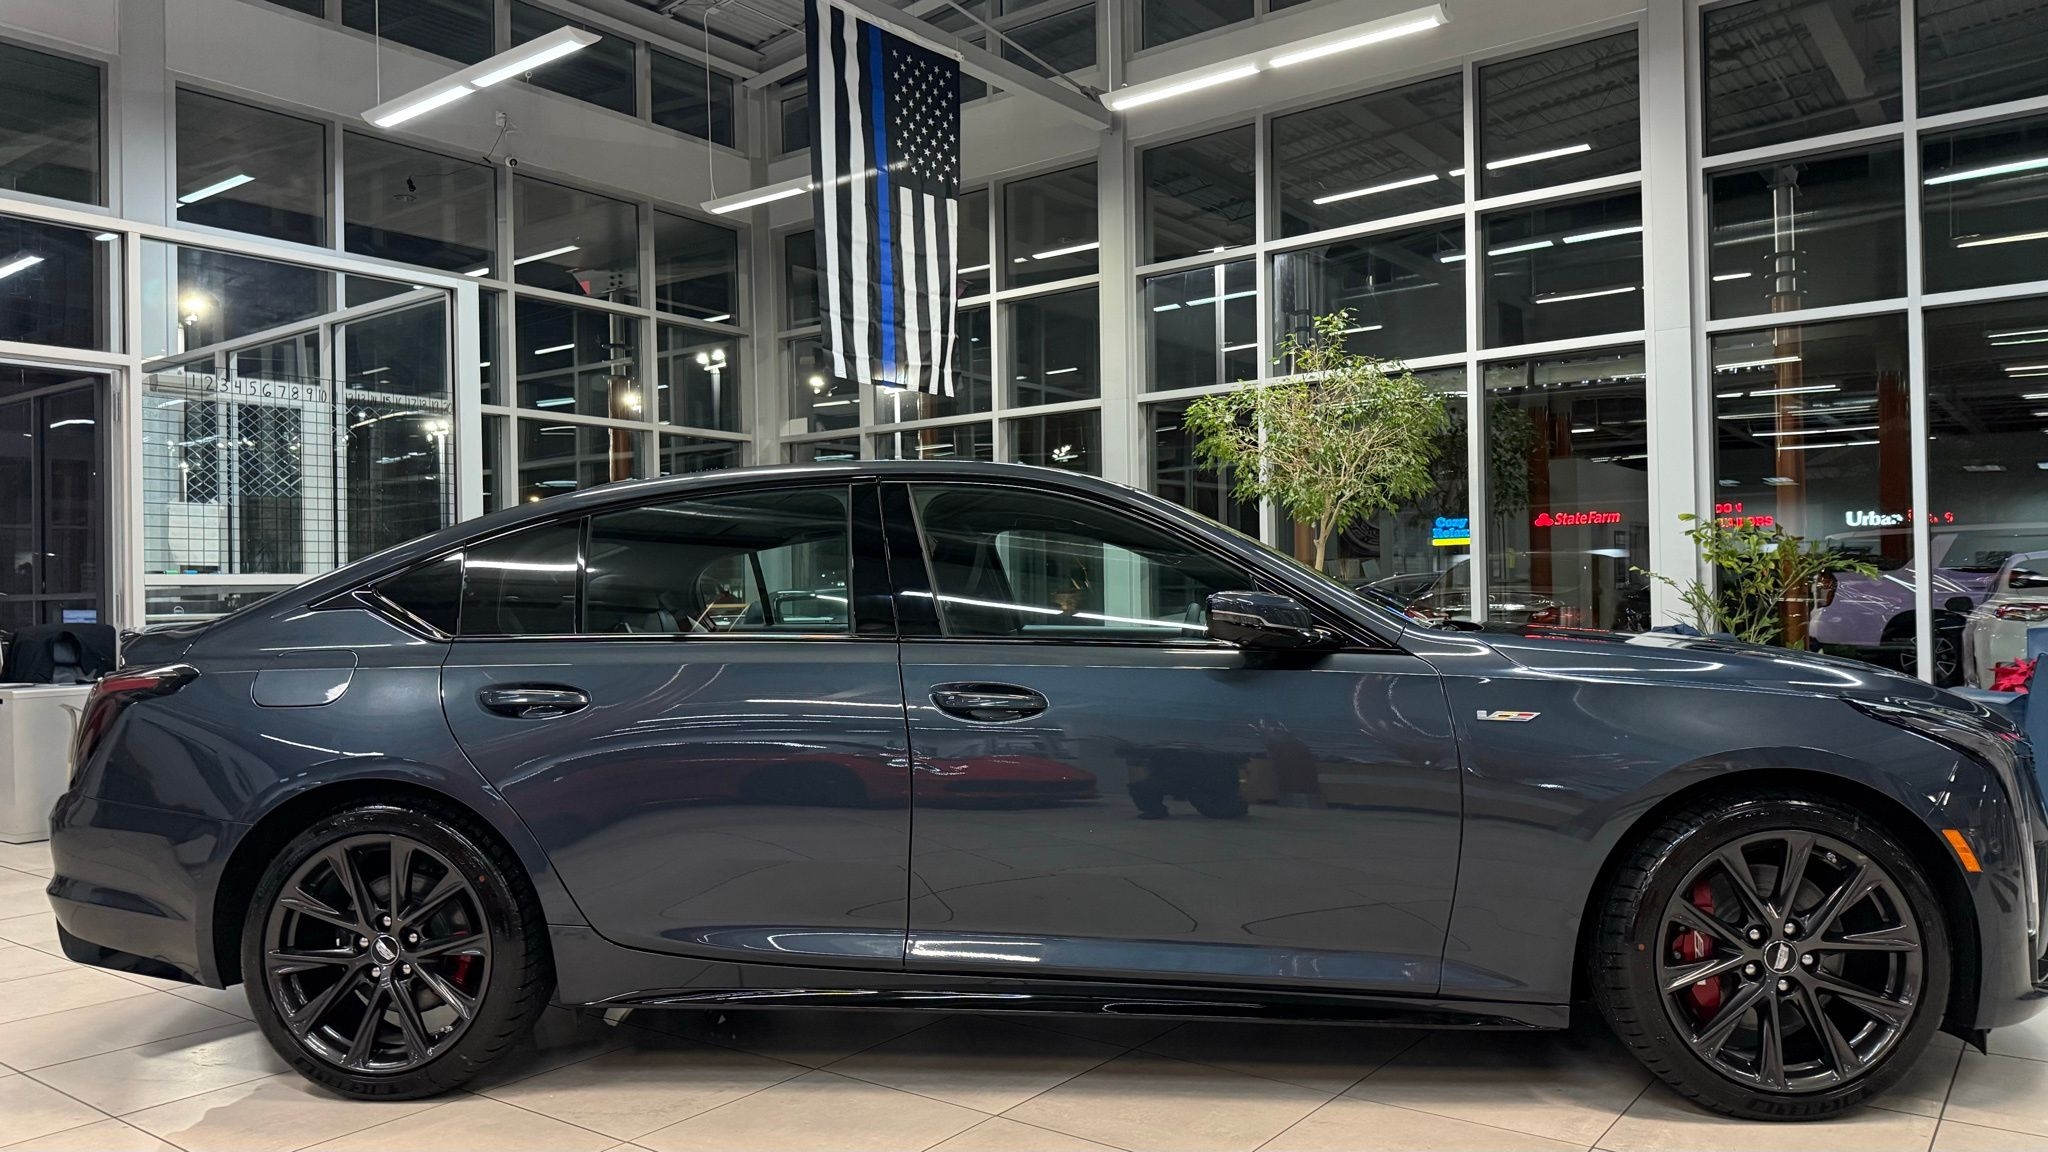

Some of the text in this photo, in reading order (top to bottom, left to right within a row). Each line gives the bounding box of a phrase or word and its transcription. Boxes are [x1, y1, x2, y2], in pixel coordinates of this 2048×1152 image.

[204, 375, 215, 392] 2
[219, 377, 229, 393] 3
[234, 379, 243, 395] 4
[249, 381, 257, 396] 5
[262, 382, 272, 398] 6
[277, 385, 287, 399] 7
[291, 386, 299, 400] 8
[306, 387, 314, 402] 9
[318, 388, 328, 403] 10
